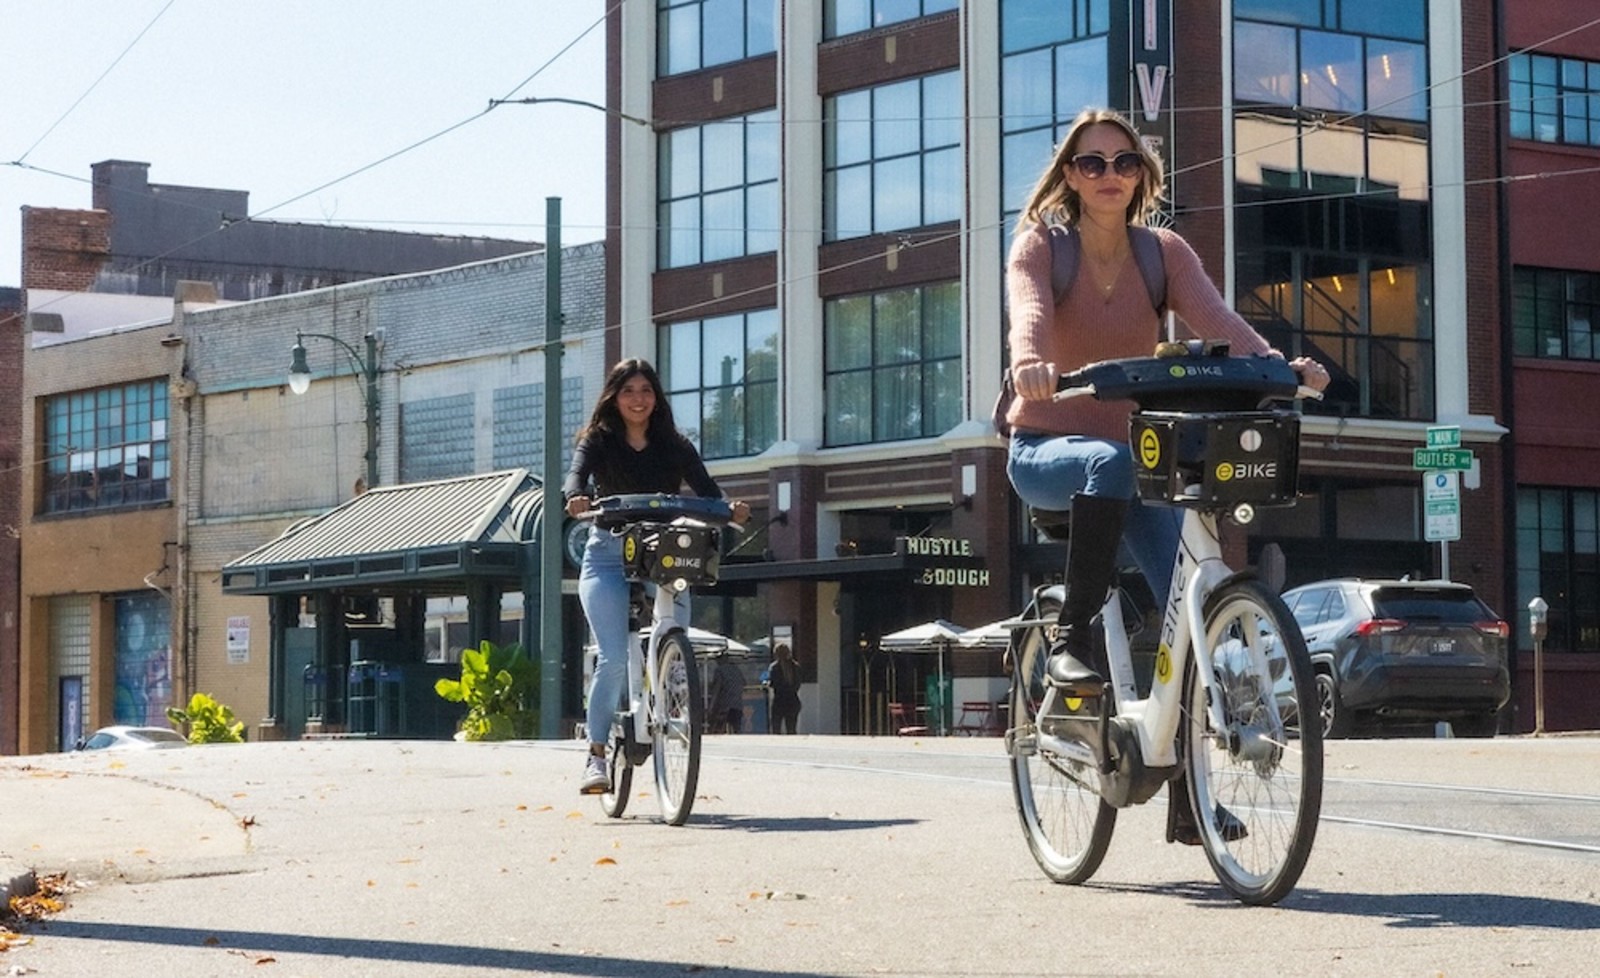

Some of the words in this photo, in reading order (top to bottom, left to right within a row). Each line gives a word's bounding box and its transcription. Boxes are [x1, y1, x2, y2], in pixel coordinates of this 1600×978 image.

[1416, 452, 1457, 467] BUTLER
[1215, 462, 1278, 482] eBIKE
[907, 537, 971, 556] HUSTLE
